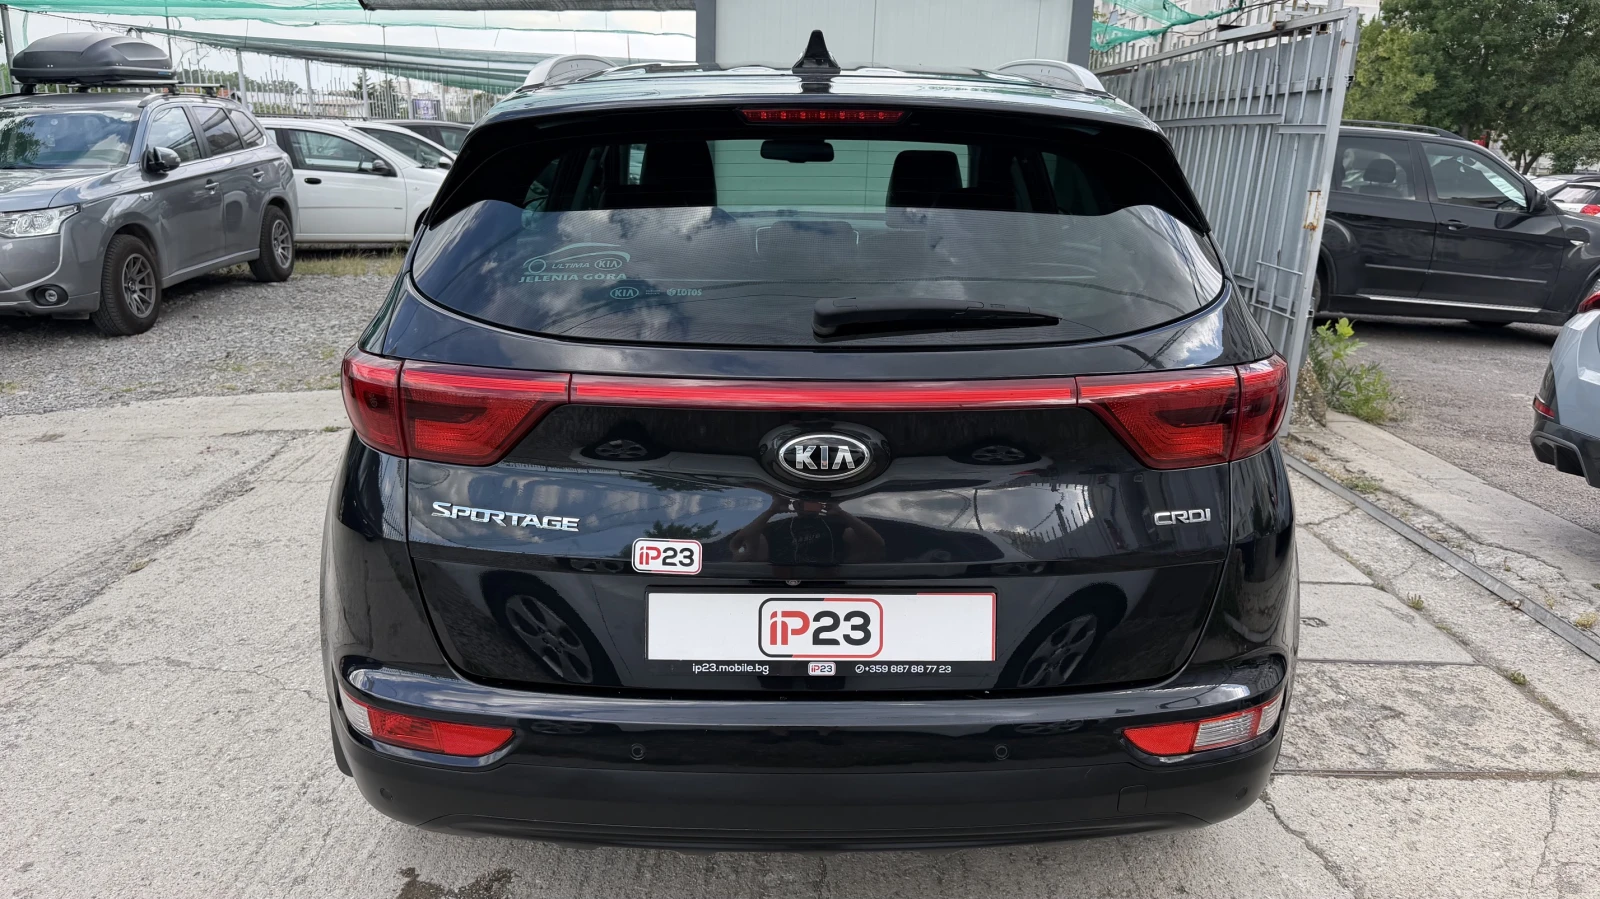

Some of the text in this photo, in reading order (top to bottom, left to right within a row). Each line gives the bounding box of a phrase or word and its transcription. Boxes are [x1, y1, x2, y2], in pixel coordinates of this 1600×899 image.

[598, 260, 618, 268] KIA
[518, 273, 579, 283] JELENIA
[614, 289, 634, 297] KIA
[676, 288, 702, 296] LOTOS
[794, 445, 856, 470] KIA
[431, 501, 581, 532] SPORTAGE
[692, 663, 769, 675] ip23.mobile.bg
[864, 665, 952, 673] +359 887 88 77 23
